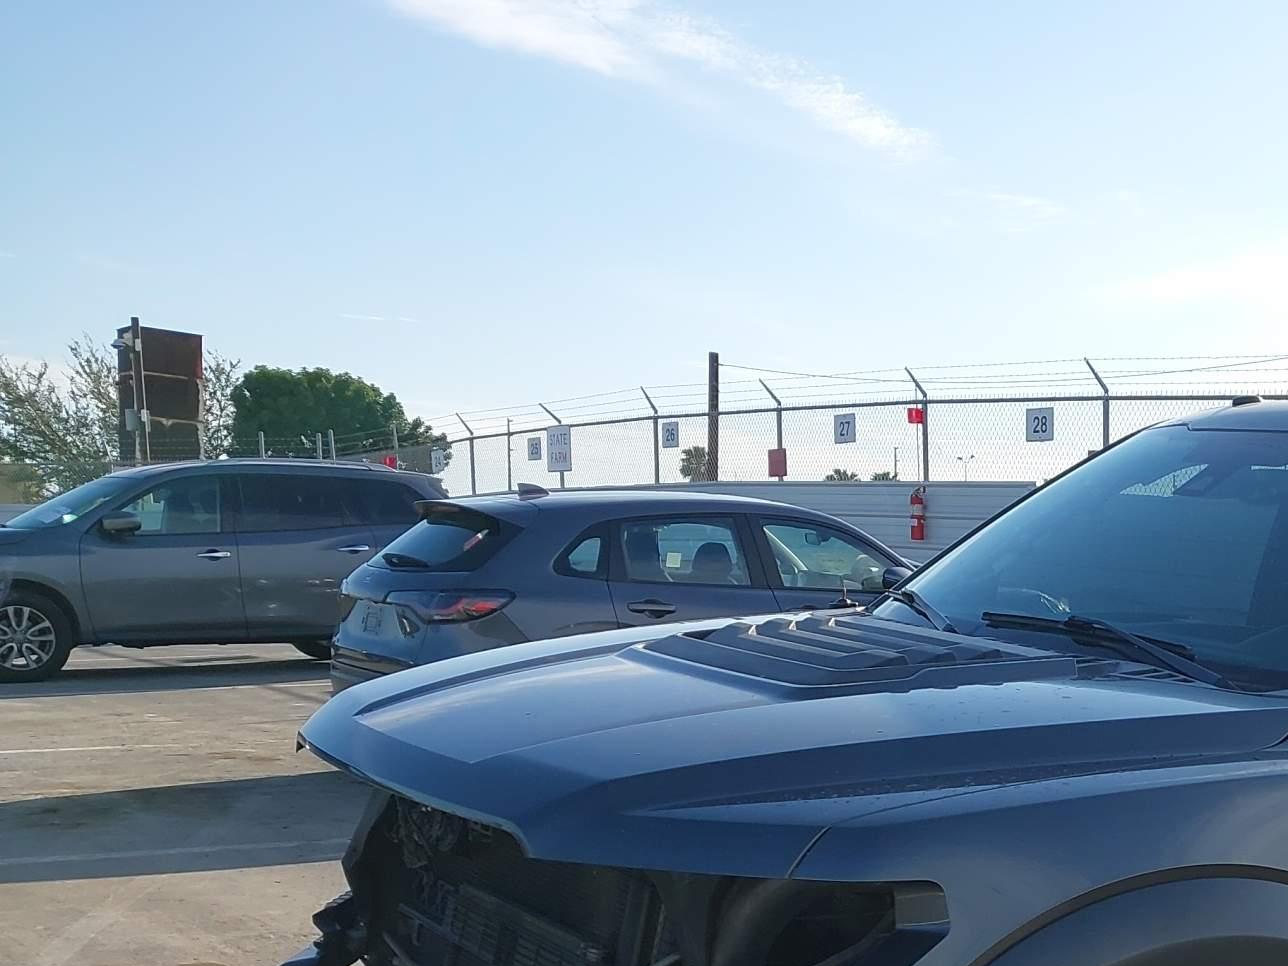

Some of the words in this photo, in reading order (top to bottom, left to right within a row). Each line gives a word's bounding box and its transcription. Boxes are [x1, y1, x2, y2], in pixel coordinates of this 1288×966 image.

[839, 421, 851, 437] 27
[1032, 415, 1048, 434] 28
[549, 433, 568, 446] STATE
[665, 428, 675, 441] 26
[550, 452, 567, 464] FARM
